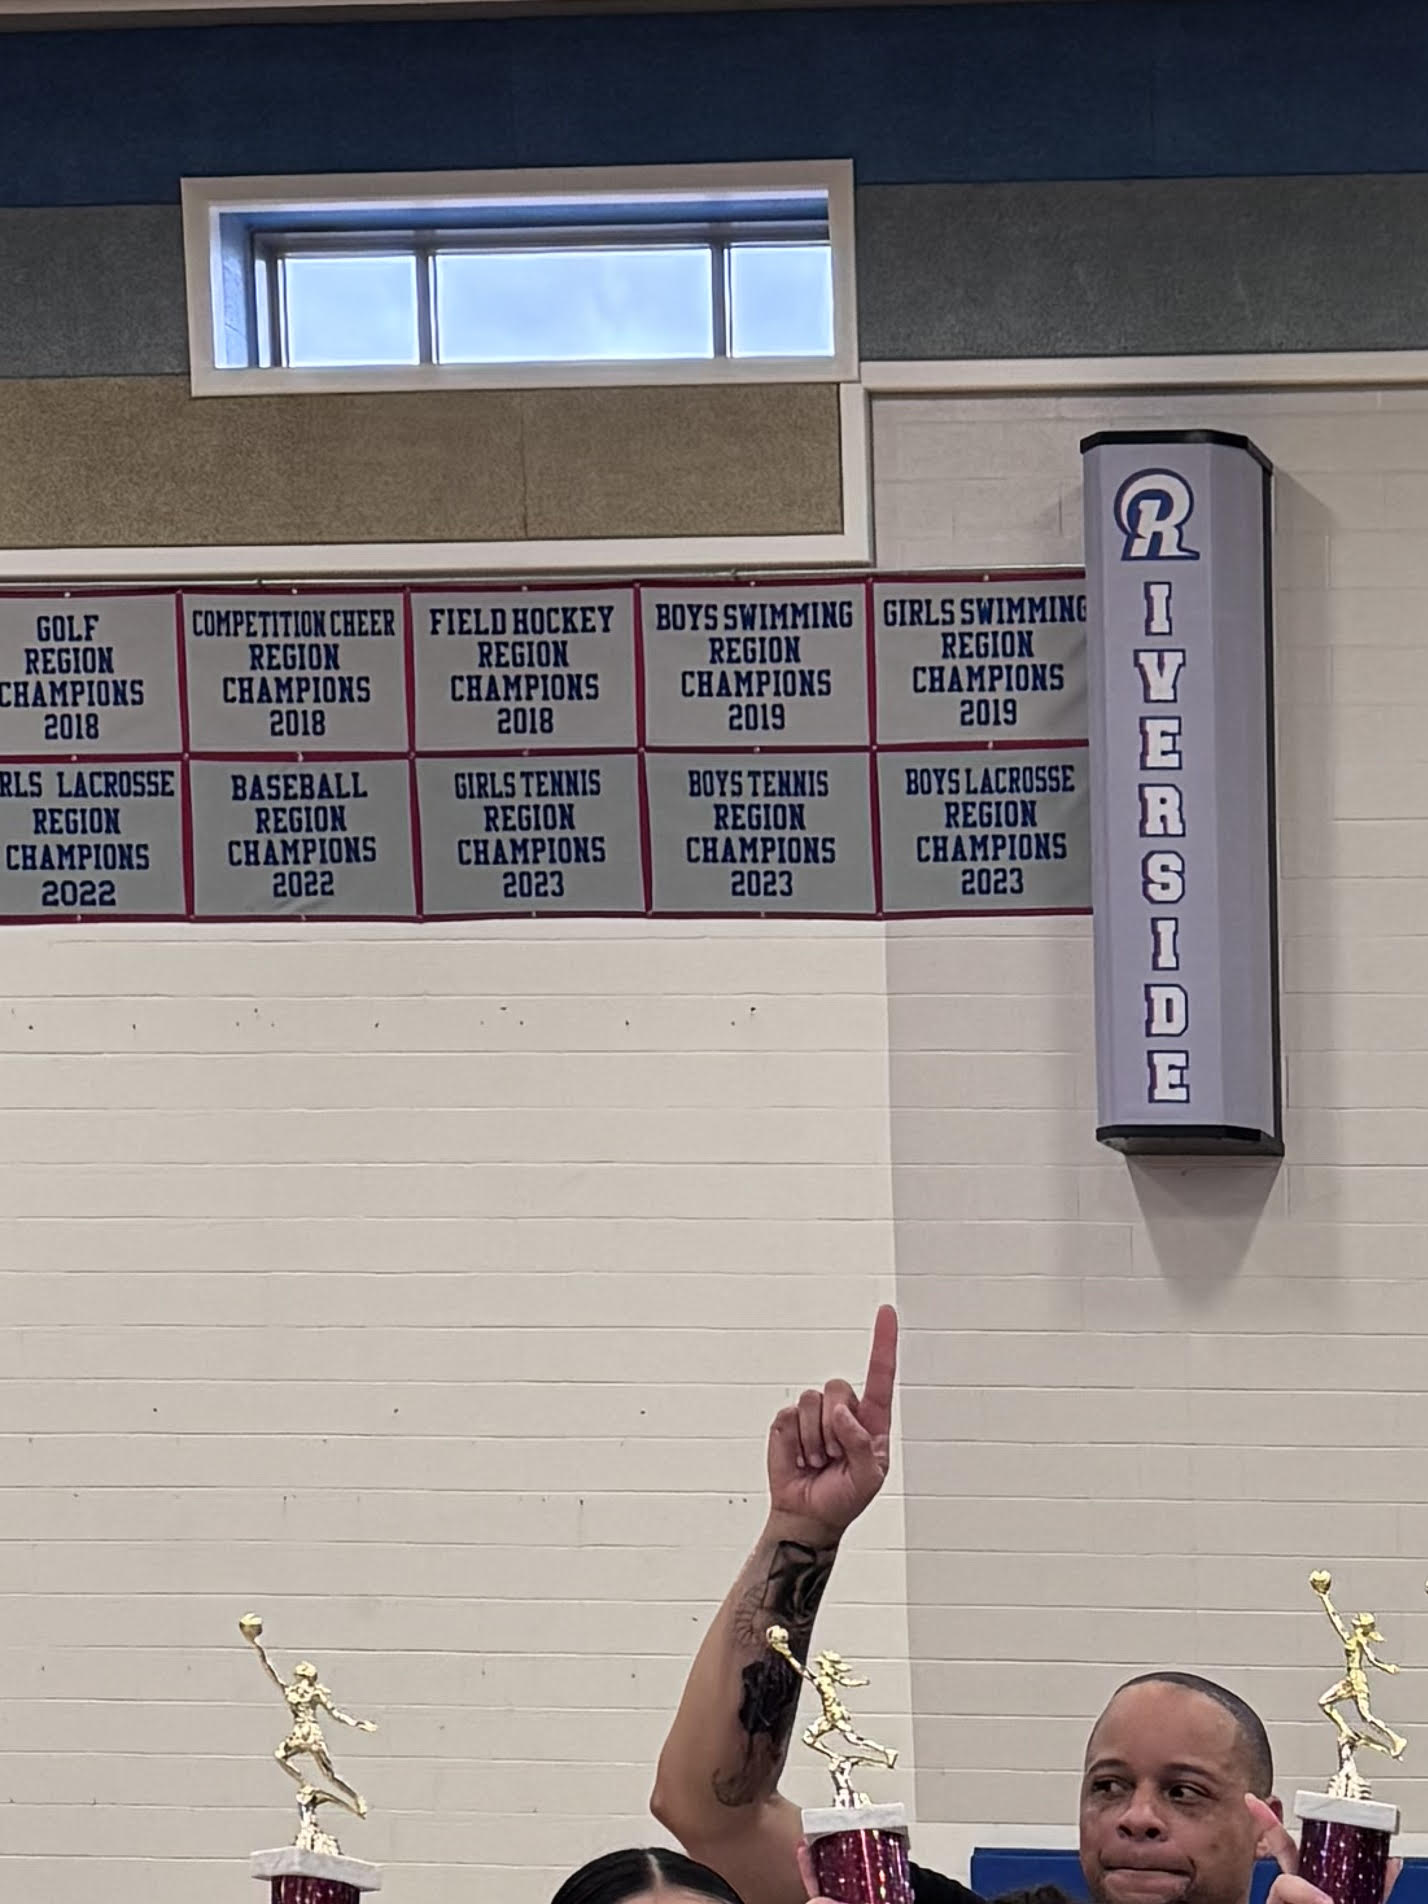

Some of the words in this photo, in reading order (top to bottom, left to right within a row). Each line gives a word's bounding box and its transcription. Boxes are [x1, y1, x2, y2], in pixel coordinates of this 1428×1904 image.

[193, 610, 326, 637] COMPETITION
[330, 609, 395, 636] CHEER
[430, 608, 506, 635] FIELD
[512, 606, 614, 634] HOCKEY
[656, 604, 717, 630] BOYS
[724, 601, 852, 630] SWIMMING
[884, 599, 954, 626] GIRLS
[961, 595, 1087, 625] SWIMMING
[37, 615, 99, 641] GOLF
[249, 644, 339, 670] REGION
[478, 640, 569, 668] REGION
[709, 636, 800, 664] REGION
[942, 631, 1034, 659] REGION
[25, 647, 114, 674] REGION
[223, 676, 370, 704] CHAMPIONS
[451, 674, 598, 701] CHAMPIONS
[682, 670, 831, 697] CHAMPIONS
[913, 664, 1064, 693] CHAMPIONS
[0, 680, 143, 707] CHAMPIONS
[45, 713, 98, 739] 2018
[270, 710, 325, 736] 2018
[498, 708, 553, 734] 2018
[729, 704, 784, 730] 2019
[961, 699, 1016, 726] 2019
[0, 771, 42, 797] RLS
[57, 771, 174, 797] LACROSSE
[232, 772, 368, 800] BASEBALL
[455, 772, 515, 799] GIRLS
[520, 770, 600, 797] TENNIS
[688, 770, 742, 797] BOYS
[748, 770, 828, 797] TENNIS
[906, 768, 959, 795] BOYS
[965, 765, 1075, 794] LACROSSE
[33, 808, 120, 834] REGION
[256, 805, 347, 833] REGION
[484, 804, 575, 832] REGION
[714, 804, 805, 830] REGION
[945, 800, 1037, 828] REGION
[7, 844, 149, 870] CHAMPIONS
[229, 837, 376, 866] CHAMPIONS
[458, 837, 605, 865] CHAMPIONS
[687, 837, 835, 863] CHAMPIONS
[917, 832, 1067, 862] CHAMPIONS
[42, 880, 116, 906] 2022
[274, 871, 334, 897] 2022
[503, 871, 564, 897] 2023
[732, 871, 792, 896] 2023
[962, 868, 1023, 895] 2023
